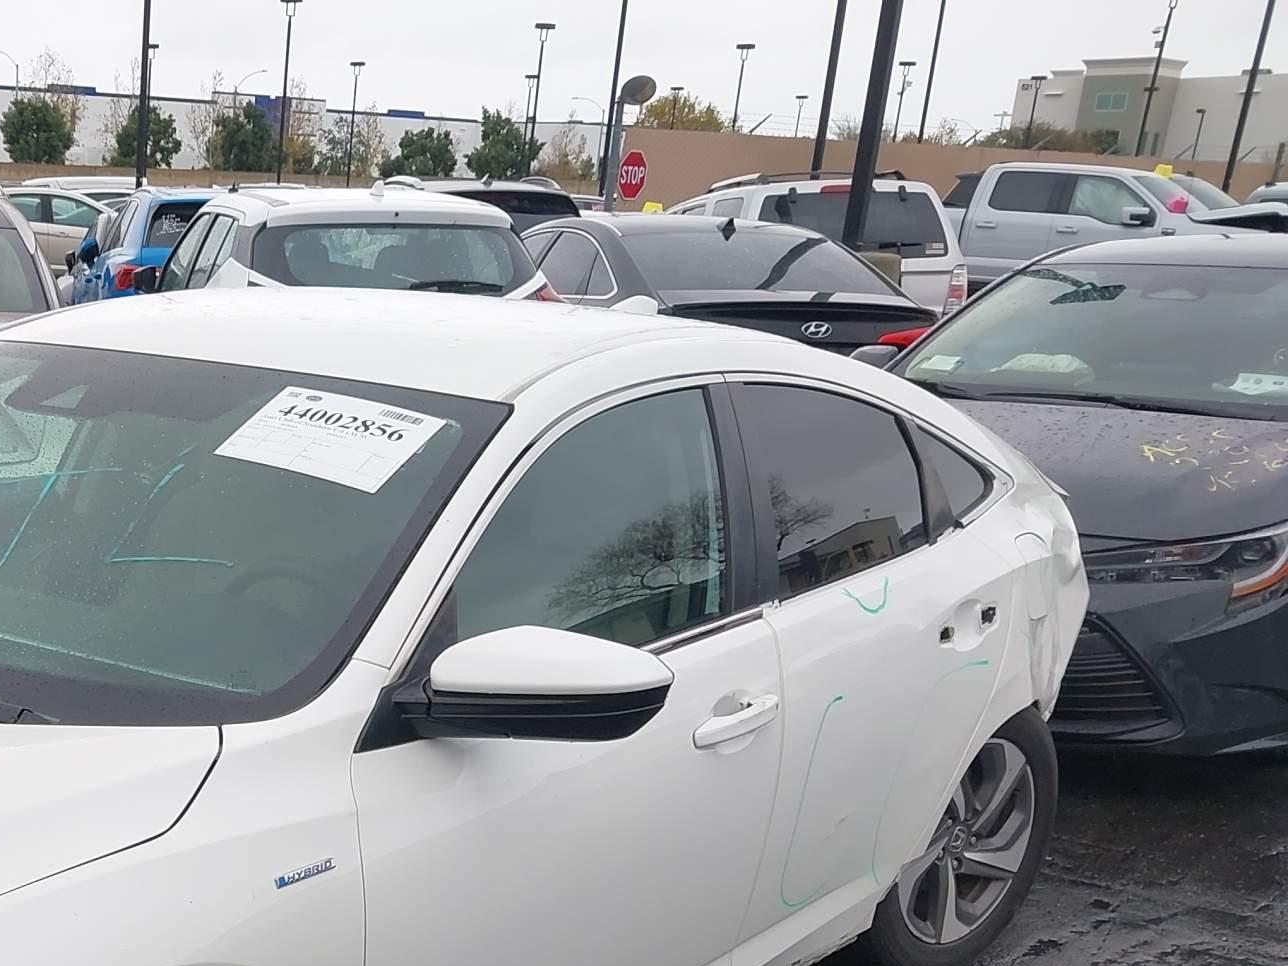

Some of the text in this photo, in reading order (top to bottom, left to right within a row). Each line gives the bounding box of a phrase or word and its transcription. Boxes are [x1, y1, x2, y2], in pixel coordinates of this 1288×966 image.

[620, 165, 646, 185] STOP
[278, 404, 409, 442] 44002856
[286, 859, 334, 884] HYBRID
